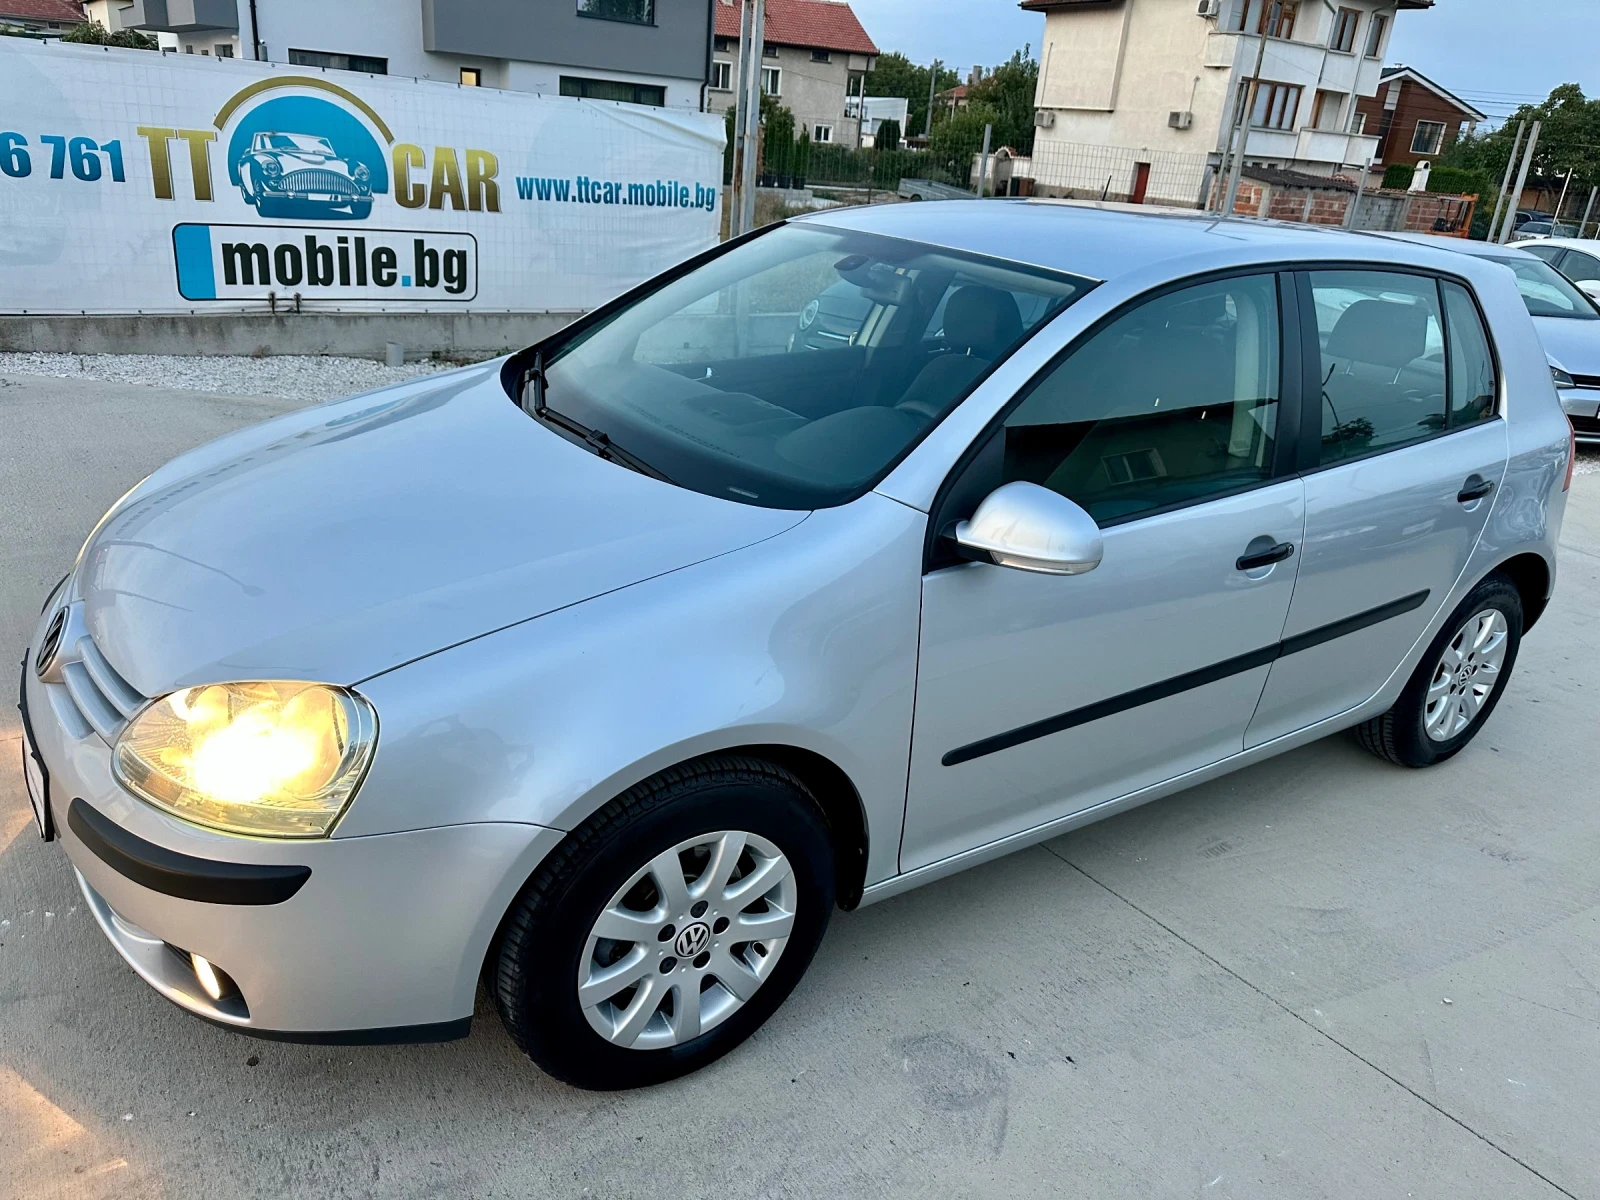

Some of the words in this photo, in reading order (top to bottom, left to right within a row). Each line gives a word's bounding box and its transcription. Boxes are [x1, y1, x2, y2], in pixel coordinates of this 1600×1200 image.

[0, 131, 32, 178] 6
[40, 134, 126, 182] 761
[137, 126, 217, 202] TT
[391, 143, 502, 213] CAR
[516, 176, 716, 212] www.ttcar.mobile.bg
[221, 235, 467, 294] mobile.bg
[675, 922, 710, 958] VW
